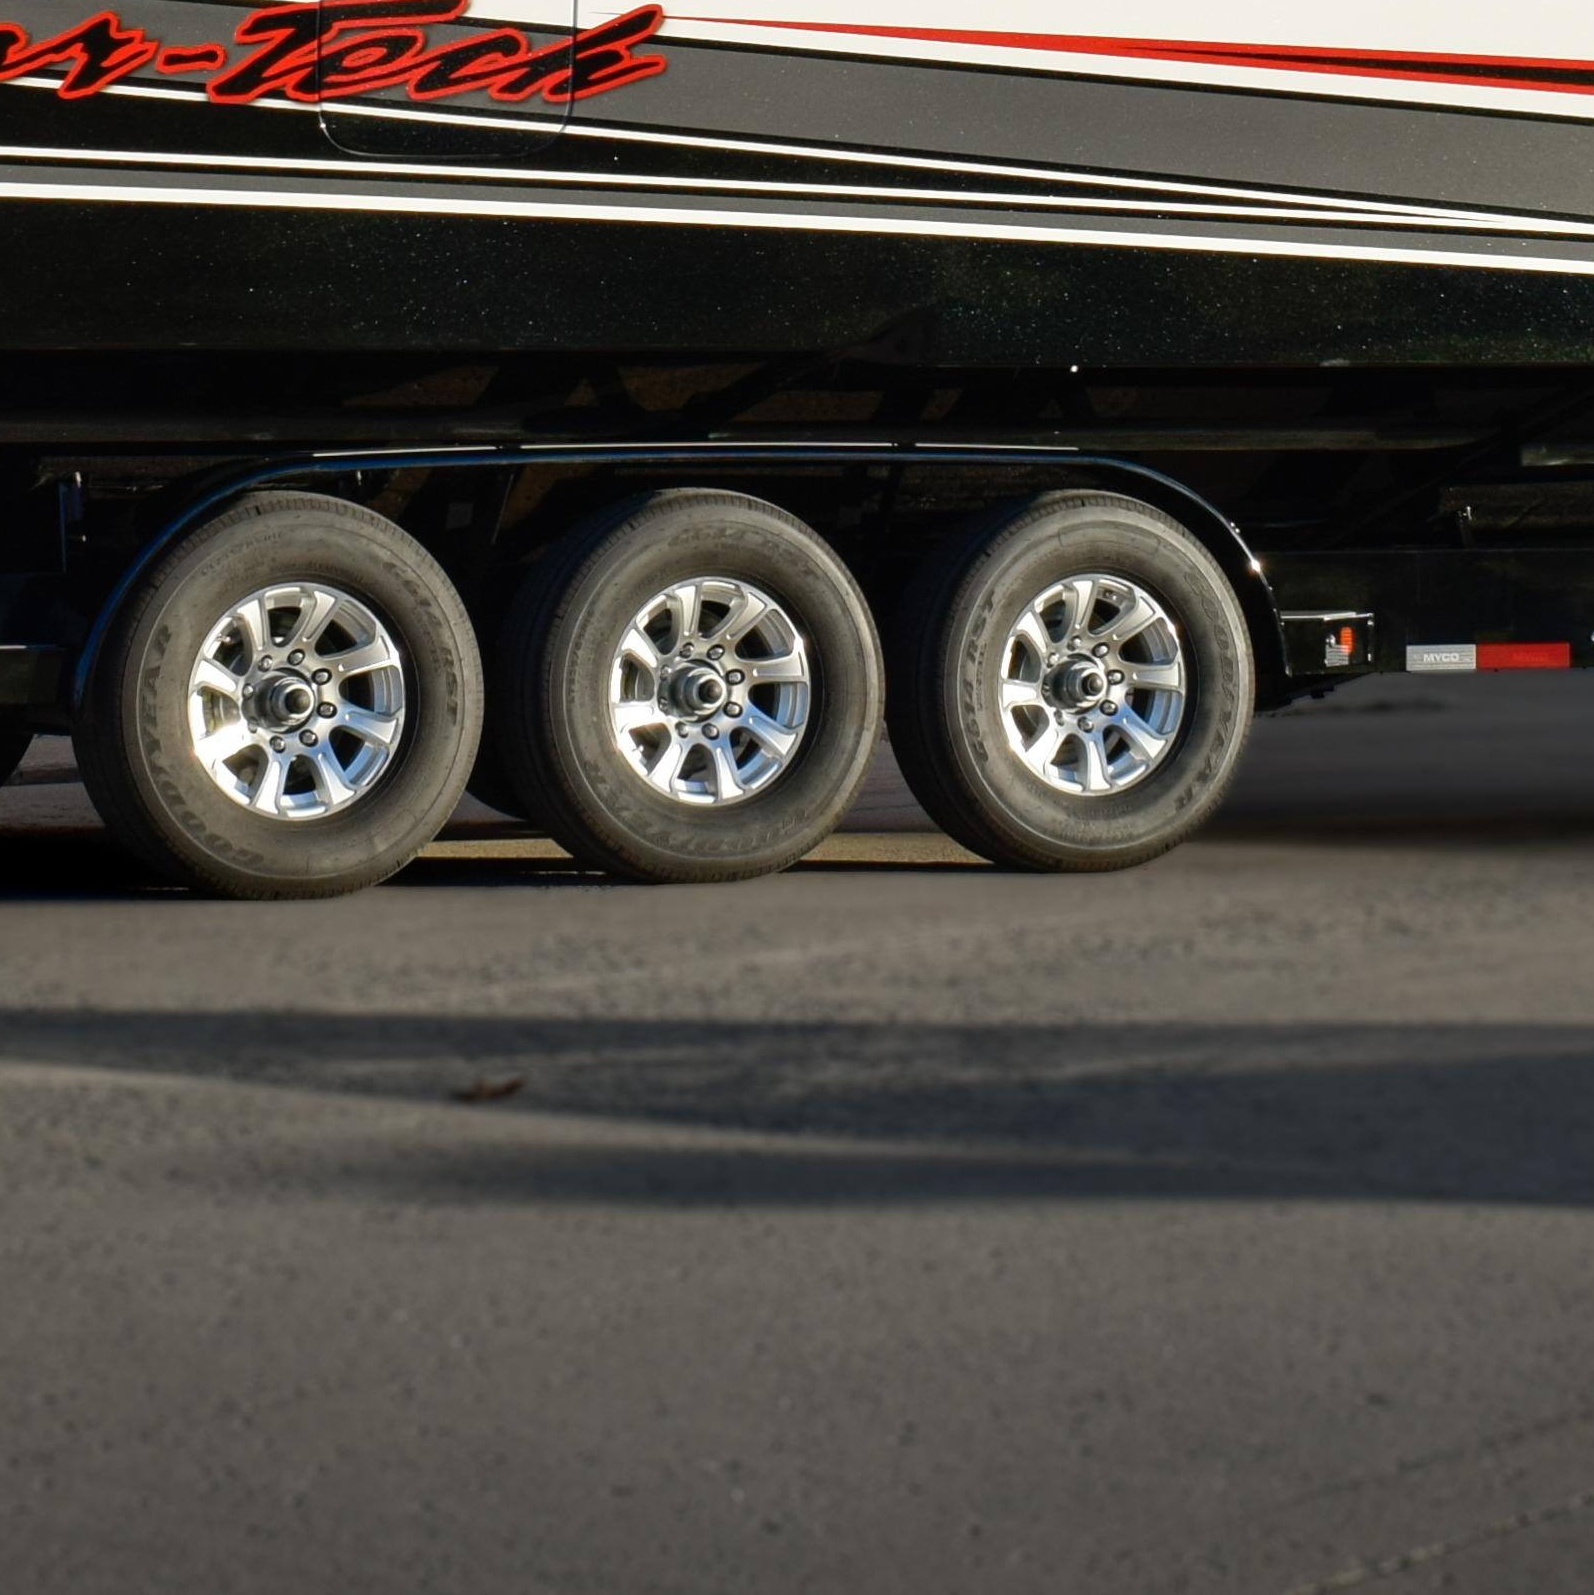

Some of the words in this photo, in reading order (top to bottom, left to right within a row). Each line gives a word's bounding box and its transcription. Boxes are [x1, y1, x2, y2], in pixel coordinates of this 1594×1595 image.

[139, 625, 265, 867] GOODYEAR
[1178, 570, 1237, 809] GOODYEAR
[1423, 653, 1459, 663] MYCO
